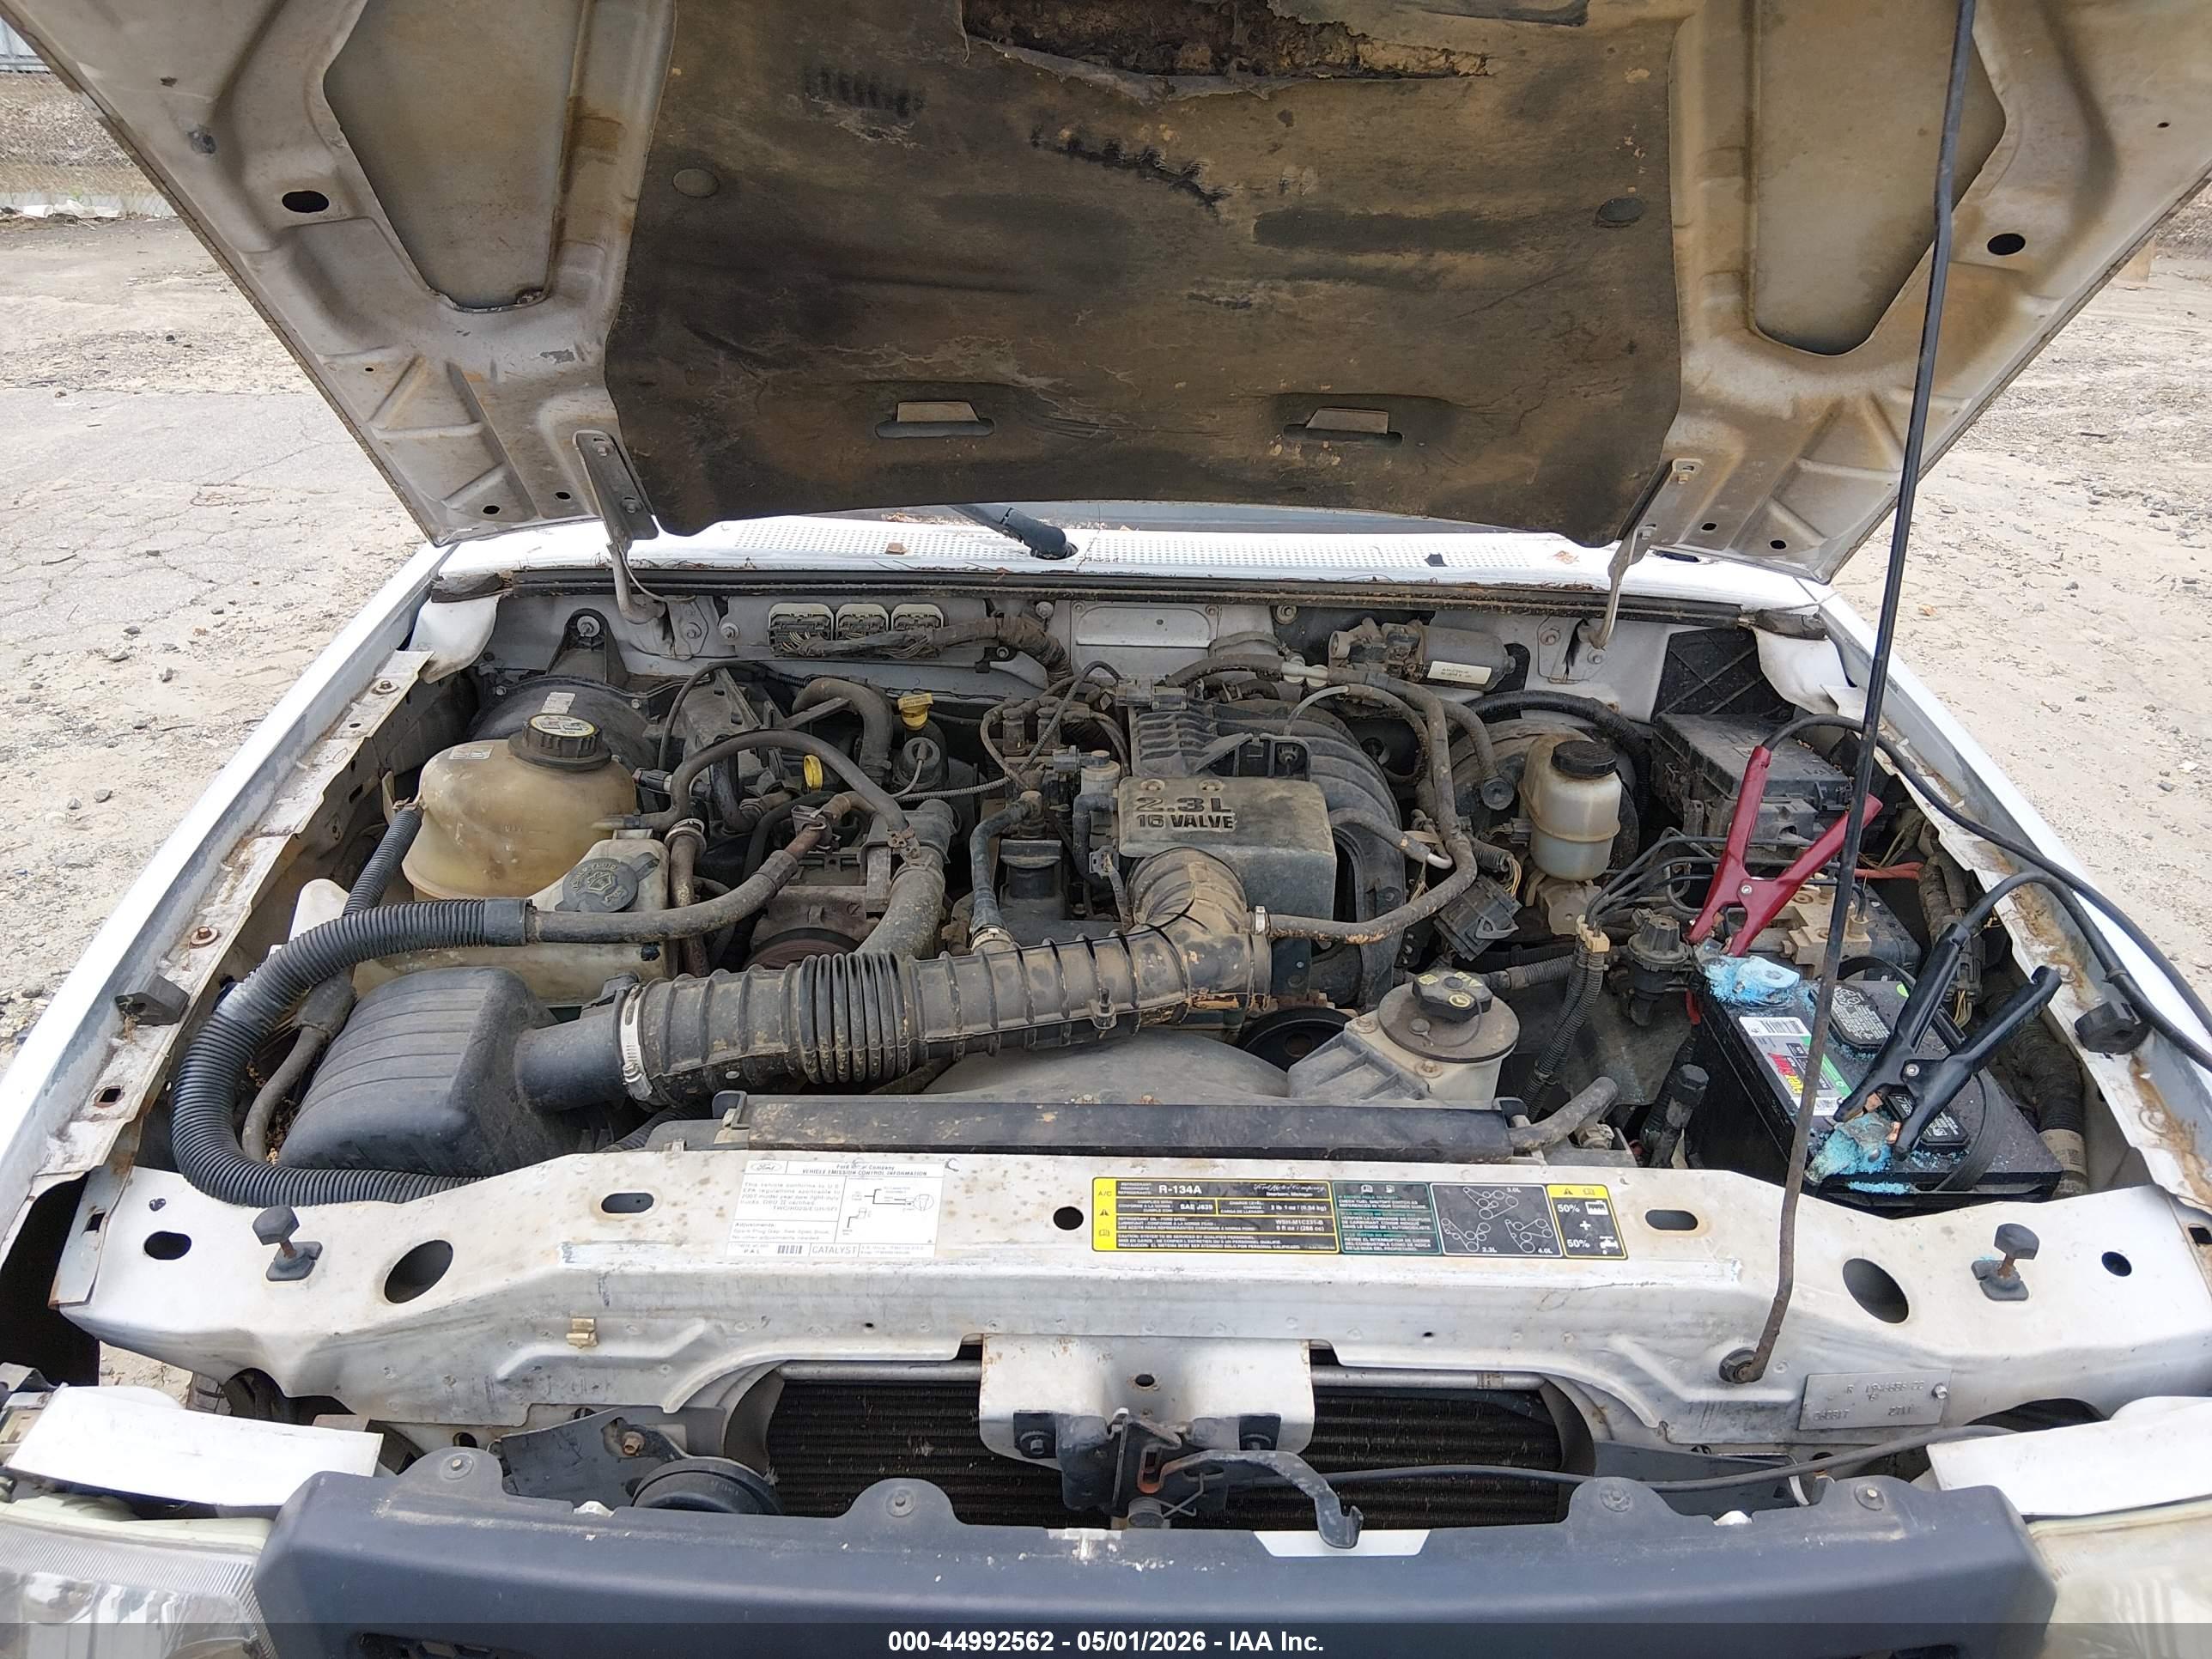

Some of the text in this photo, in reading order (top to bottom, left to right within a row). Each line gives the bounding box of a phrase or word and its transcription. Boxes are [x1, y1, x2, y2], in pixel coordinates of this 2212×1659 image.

[1135, 796, 1231, 812] 2.3L
[1136, 814, 1234, 829] 16 VALVE
[1158, 1185, 1202, 1194] R-134A
[1557, 1204, 1580, 1213] 50%
[1567, 1239, 1590, 1249] 50%
[812, 1246, 857, 1255] CATALYST
